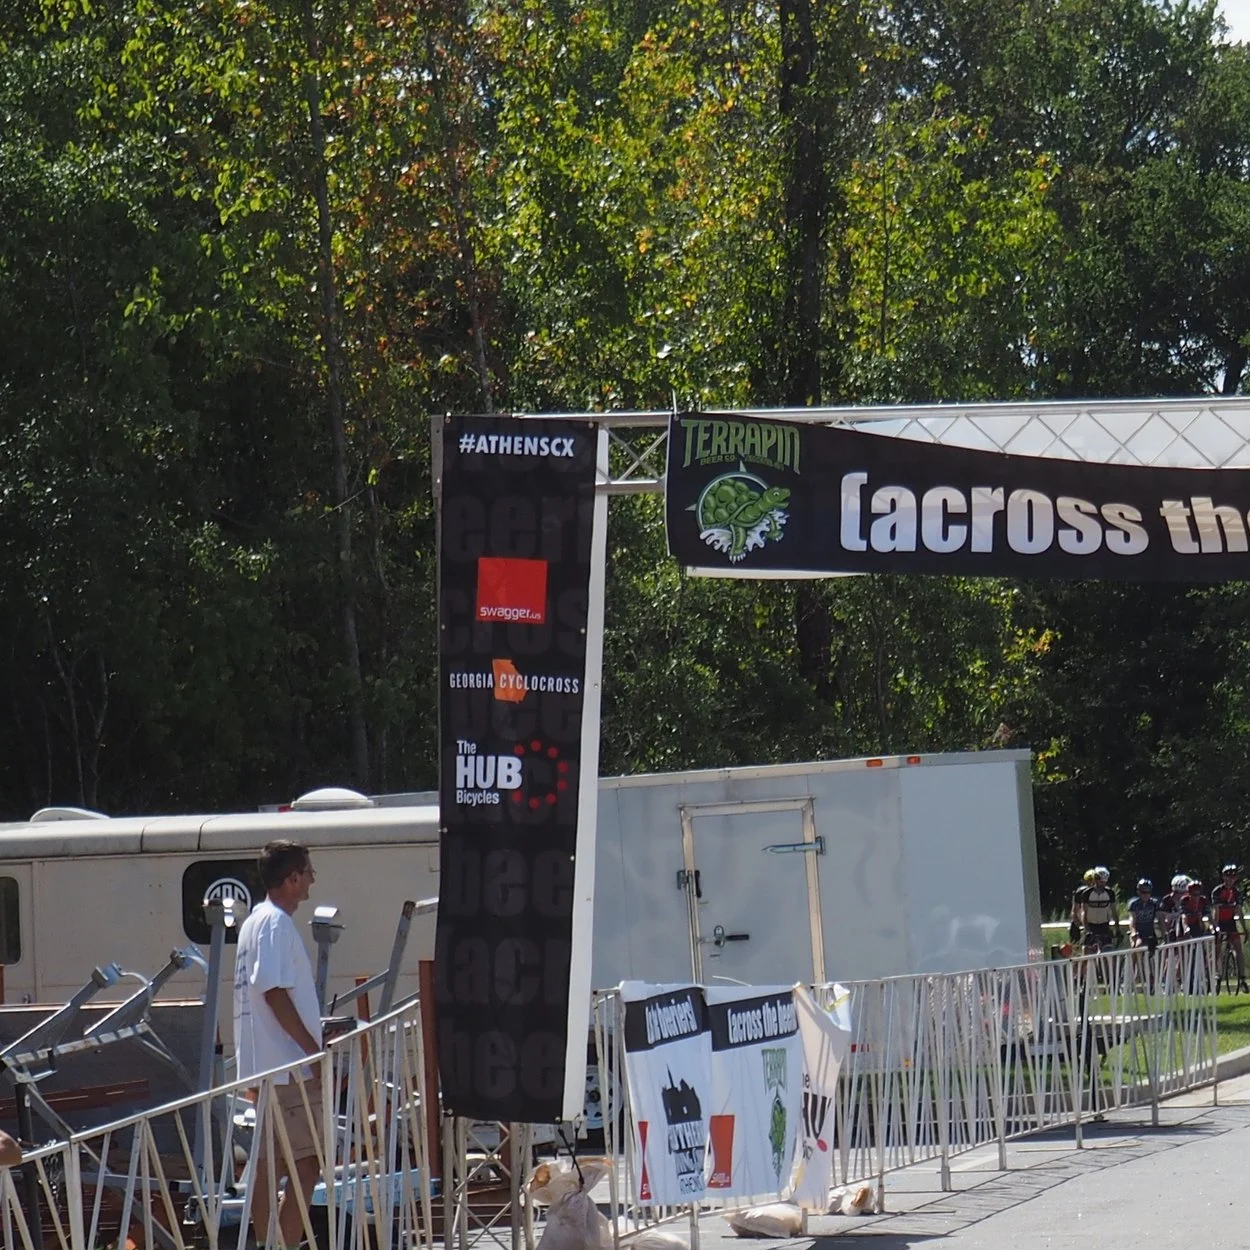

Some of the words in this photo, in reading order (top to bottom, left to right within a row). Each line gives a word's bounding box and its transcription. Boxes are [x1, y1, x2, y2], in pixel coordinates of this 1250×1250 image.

[458, 433, 575, 458] #ATHENSCX
[680, 419, 800, 475] TERRAPIN
[449, 672, 494, 689] GEORGIA
[499, 673, 580, 694] CYCLOCROSS
[456, 740, 477, 755] The
[456, 755, 523, 791] HUB
[456, 789, 499, 806] Bicycles
[762, 1001, 778, 1037] the
